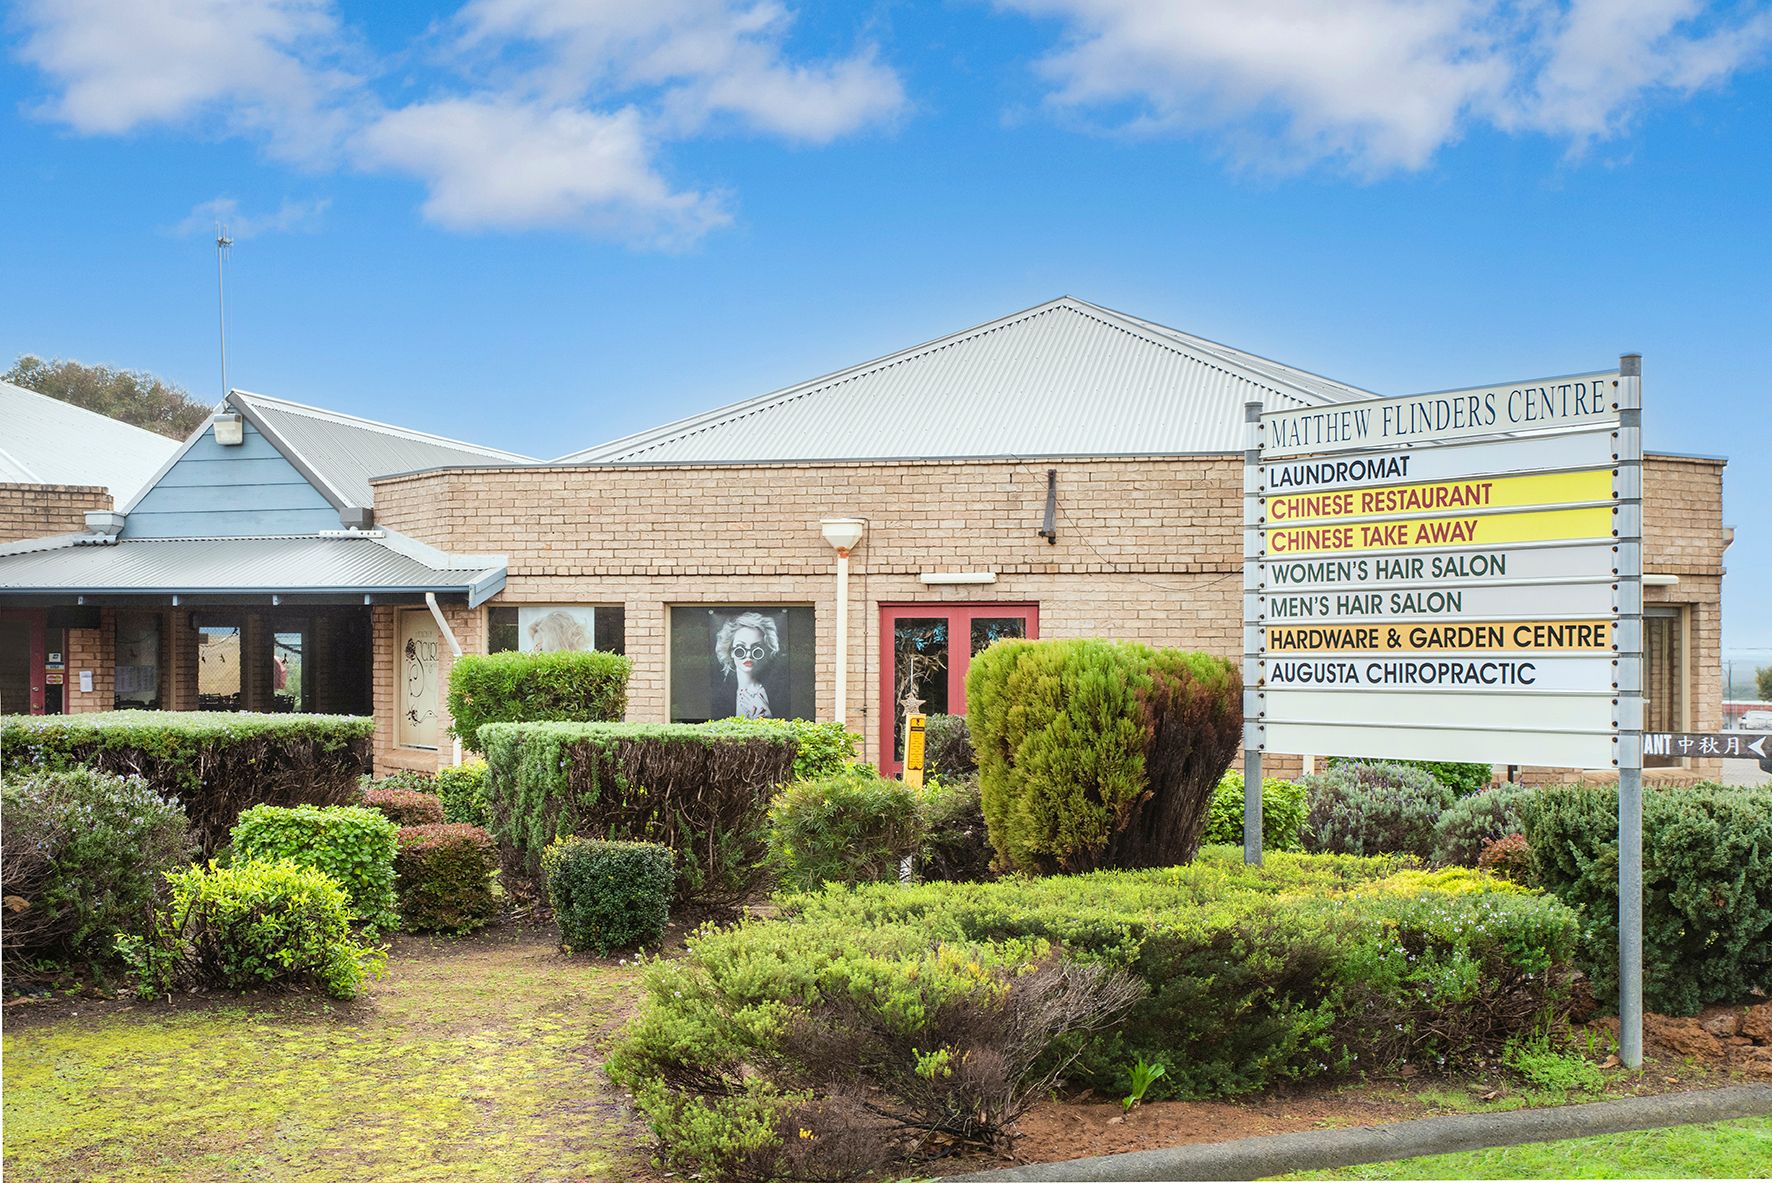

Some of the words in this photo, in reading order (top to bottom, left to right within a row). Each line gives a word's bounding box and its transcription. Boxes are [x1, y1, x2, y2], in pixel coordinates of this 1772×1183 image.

[1271, 409, 1370, 448] MATTHEW
[1382, 393, 1496, 436] FLINDERS
[1508, 380, 1605, 423] CENTRE
[1270, 456, 1410, 488] LAUNDROMAT
[1271, 494, 1354, 520] CHINESE
[1361, 483, 1492, 512] RESTAURANT
[1271, 528, 1354, 552] CHINESE
[1361, 524, 1407, 547] TAKE
[1415, 520, 1478, 545] AWAY
[1272, 560, 1368, 583] WOMEN'S
[1375, 557, 1424, 579] HAIR
[1431, 554, 1506, 578] SALON
[1271, 597, 1329, 617] MEN'S
[1336, 594, 1382, 615] HAIR
[1390, 591, 1462, 613] SALON
[1270, 628, 1379, 649] HARDWARE
[1387, 628, 1402, 648] &
[1408, 626, 1504, 649] GARDEN
[1513, 624, 1605, 648] CENTRE
[1270, 662, 1360, 684] AUGUSTA
[1366, 662, 1536, 685] CHIROPRACTIC
[1678, 735, 1738, 756] 中秋月
